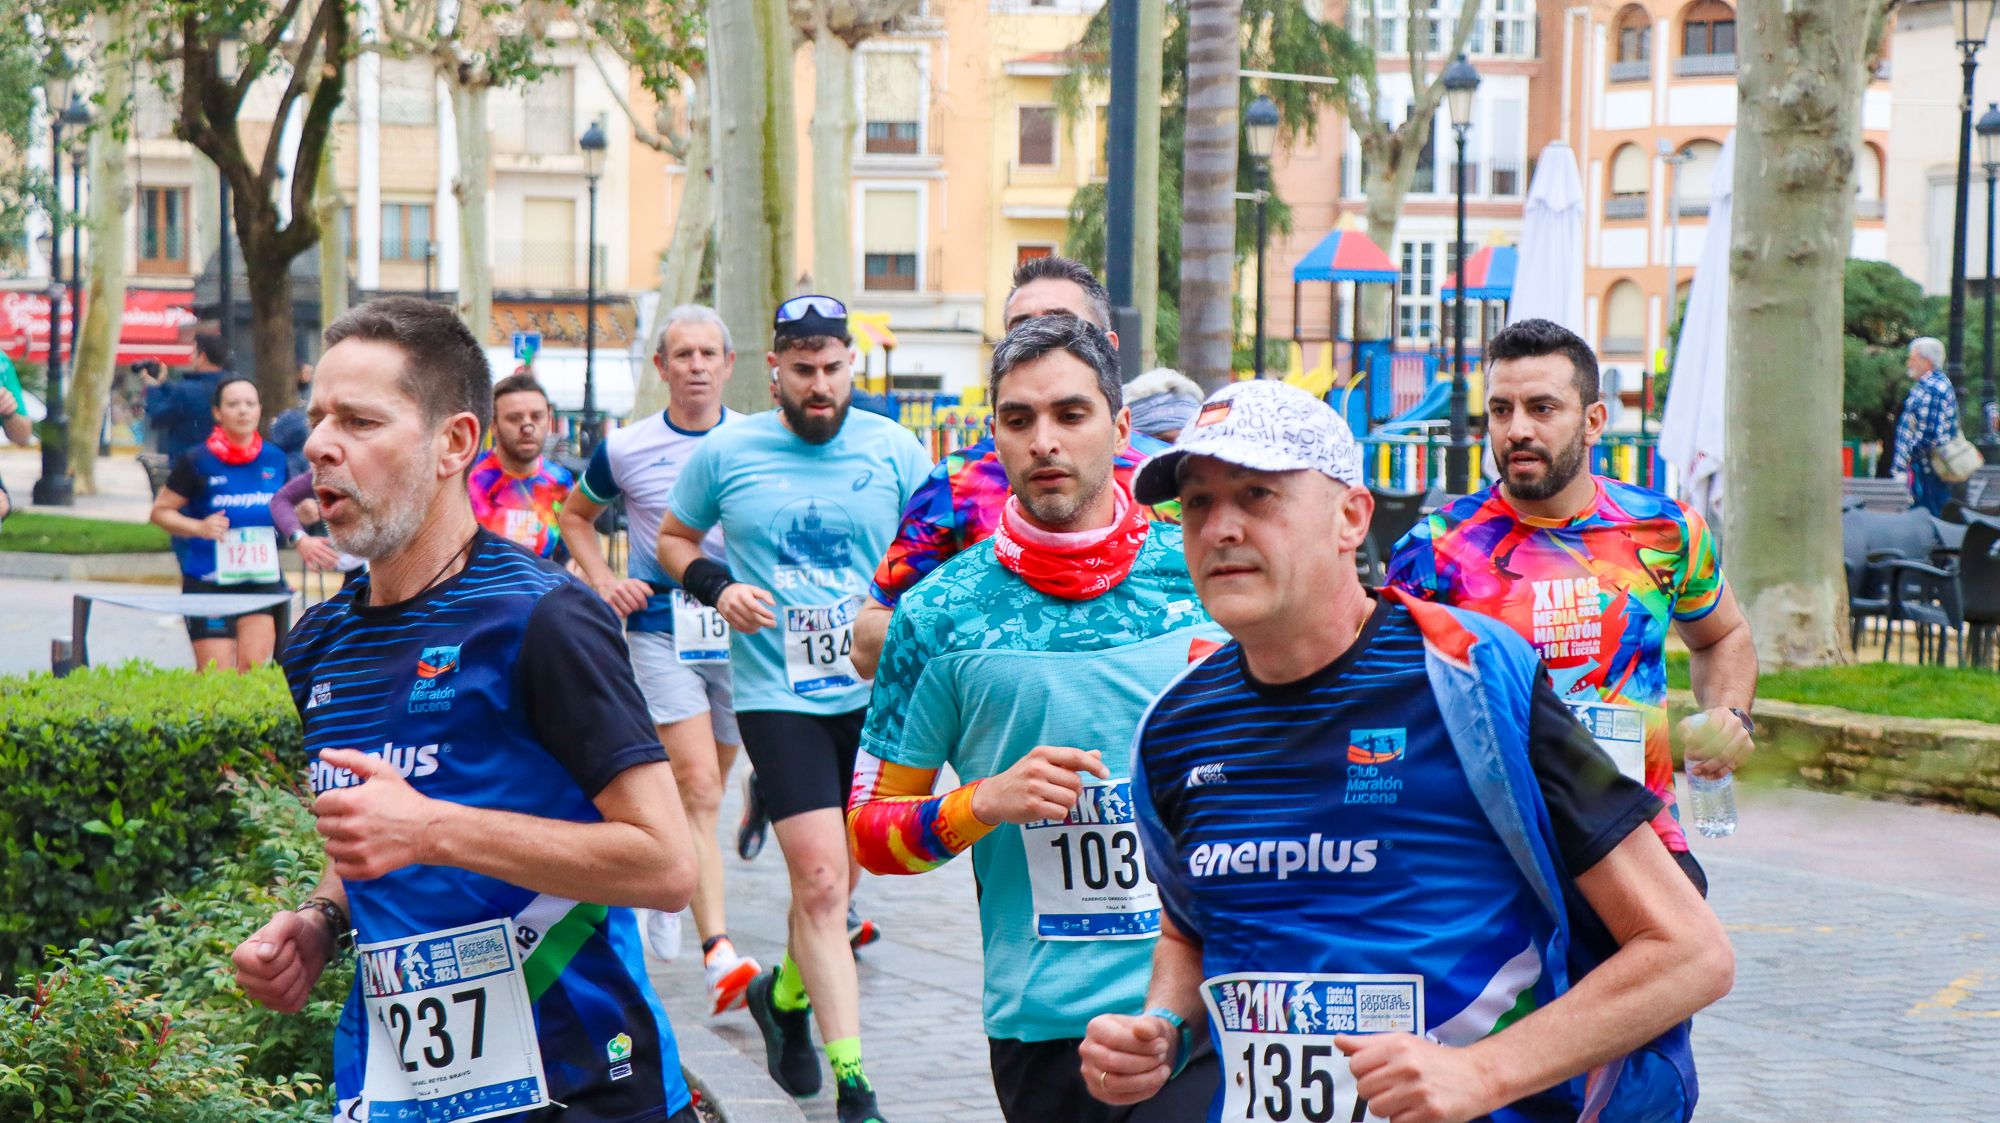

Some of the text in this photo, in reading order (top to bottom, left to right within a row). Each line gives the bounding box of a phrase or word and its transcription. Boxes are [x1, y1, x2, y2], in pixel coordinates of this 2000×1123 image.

[774, 566, 859, 591] SEVILLA
[1531, 579, 1576, 611] XII
[1533, 608, 1579, 627] MEDIA
[1534, 620, 1602, 643] MARATÓN
[1544, 641, 1569, 659] 10K
[1571, 646, 1600, 656] LUCENA
[410, 687, 456, 702] Maratón
[408, 701, 451, 713] Lucena
[1200, 763, 1224, 774] RUN
[1347, 764, 1378, 777] Club
[1347, 775, 1403, 790] Maratón
[1344, 791, 1398, 804] Lucena
[1189, 833, 1378, 880] enerplus
[434, 966, 459, 984] 2026
[1326, 994, 1353, 1005] LUCENA
[1360, 993, 1402, 1003] carreras
[1237, 981, 1289, 1032] 21K
[1360, 1000, 1411, 1012] populares
[1326, 1014, 1355, 1031] 2026
